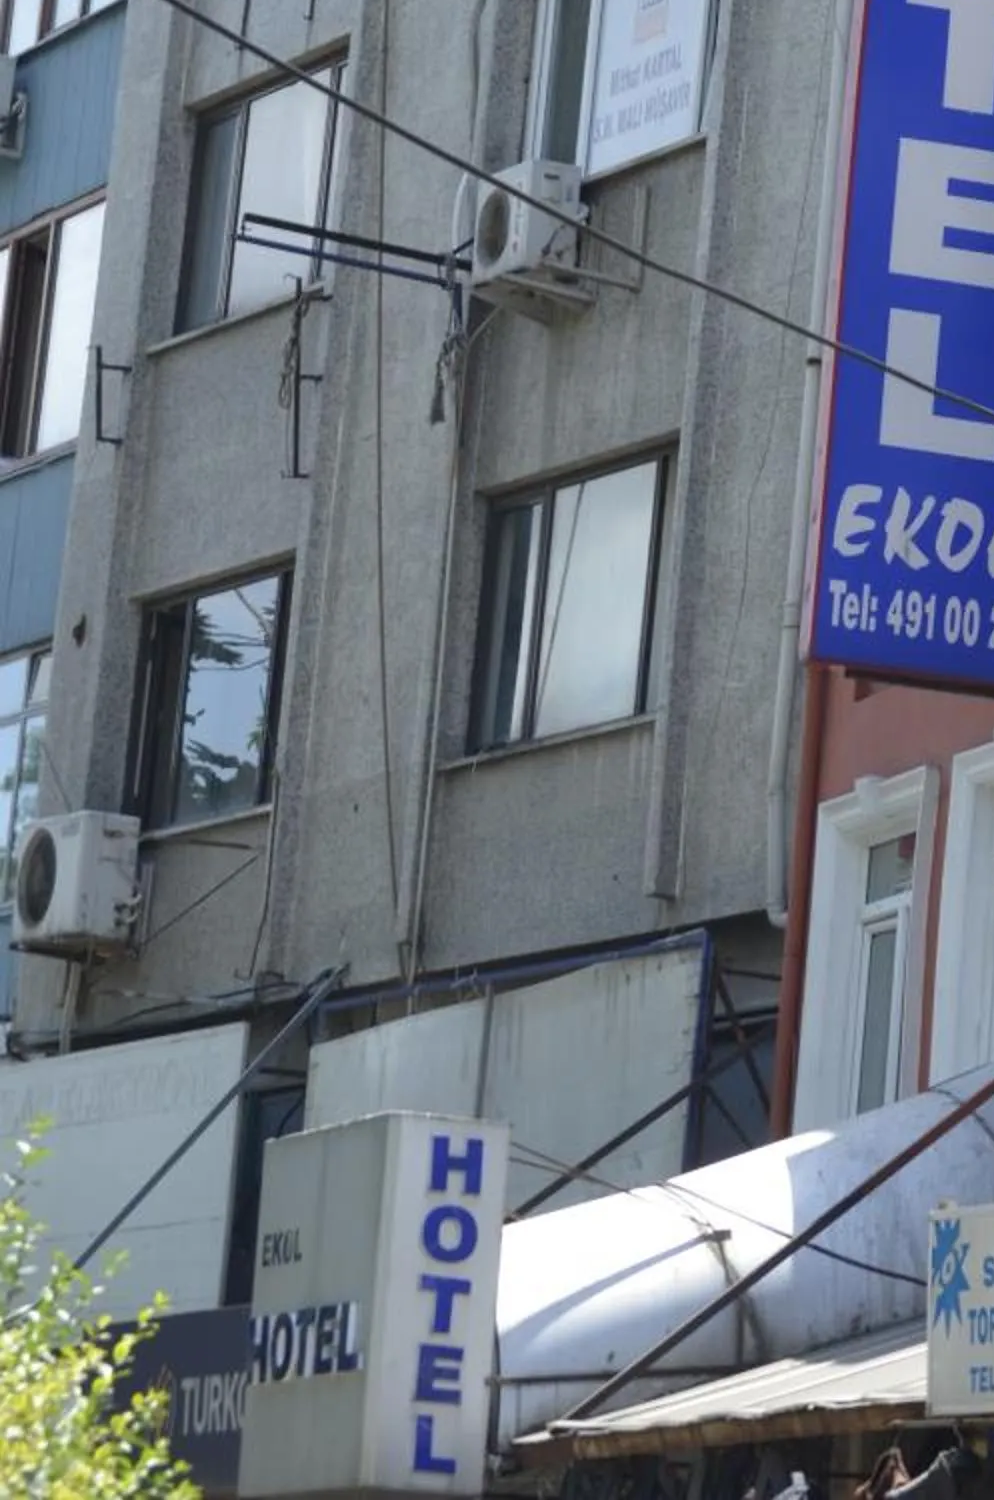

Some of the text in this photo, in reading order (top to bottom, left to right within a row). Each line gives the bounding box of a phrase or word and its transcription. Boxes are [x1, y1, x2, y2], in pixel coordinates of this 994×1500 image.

[828, 579, 879, 633] Tel:
[886, 589, 937, 641] 491
[943, 596, 981, 647] 00
[250, 1301, 361, 1384] HOTEL
[413, 1135, 484, 1475] HOTEL
